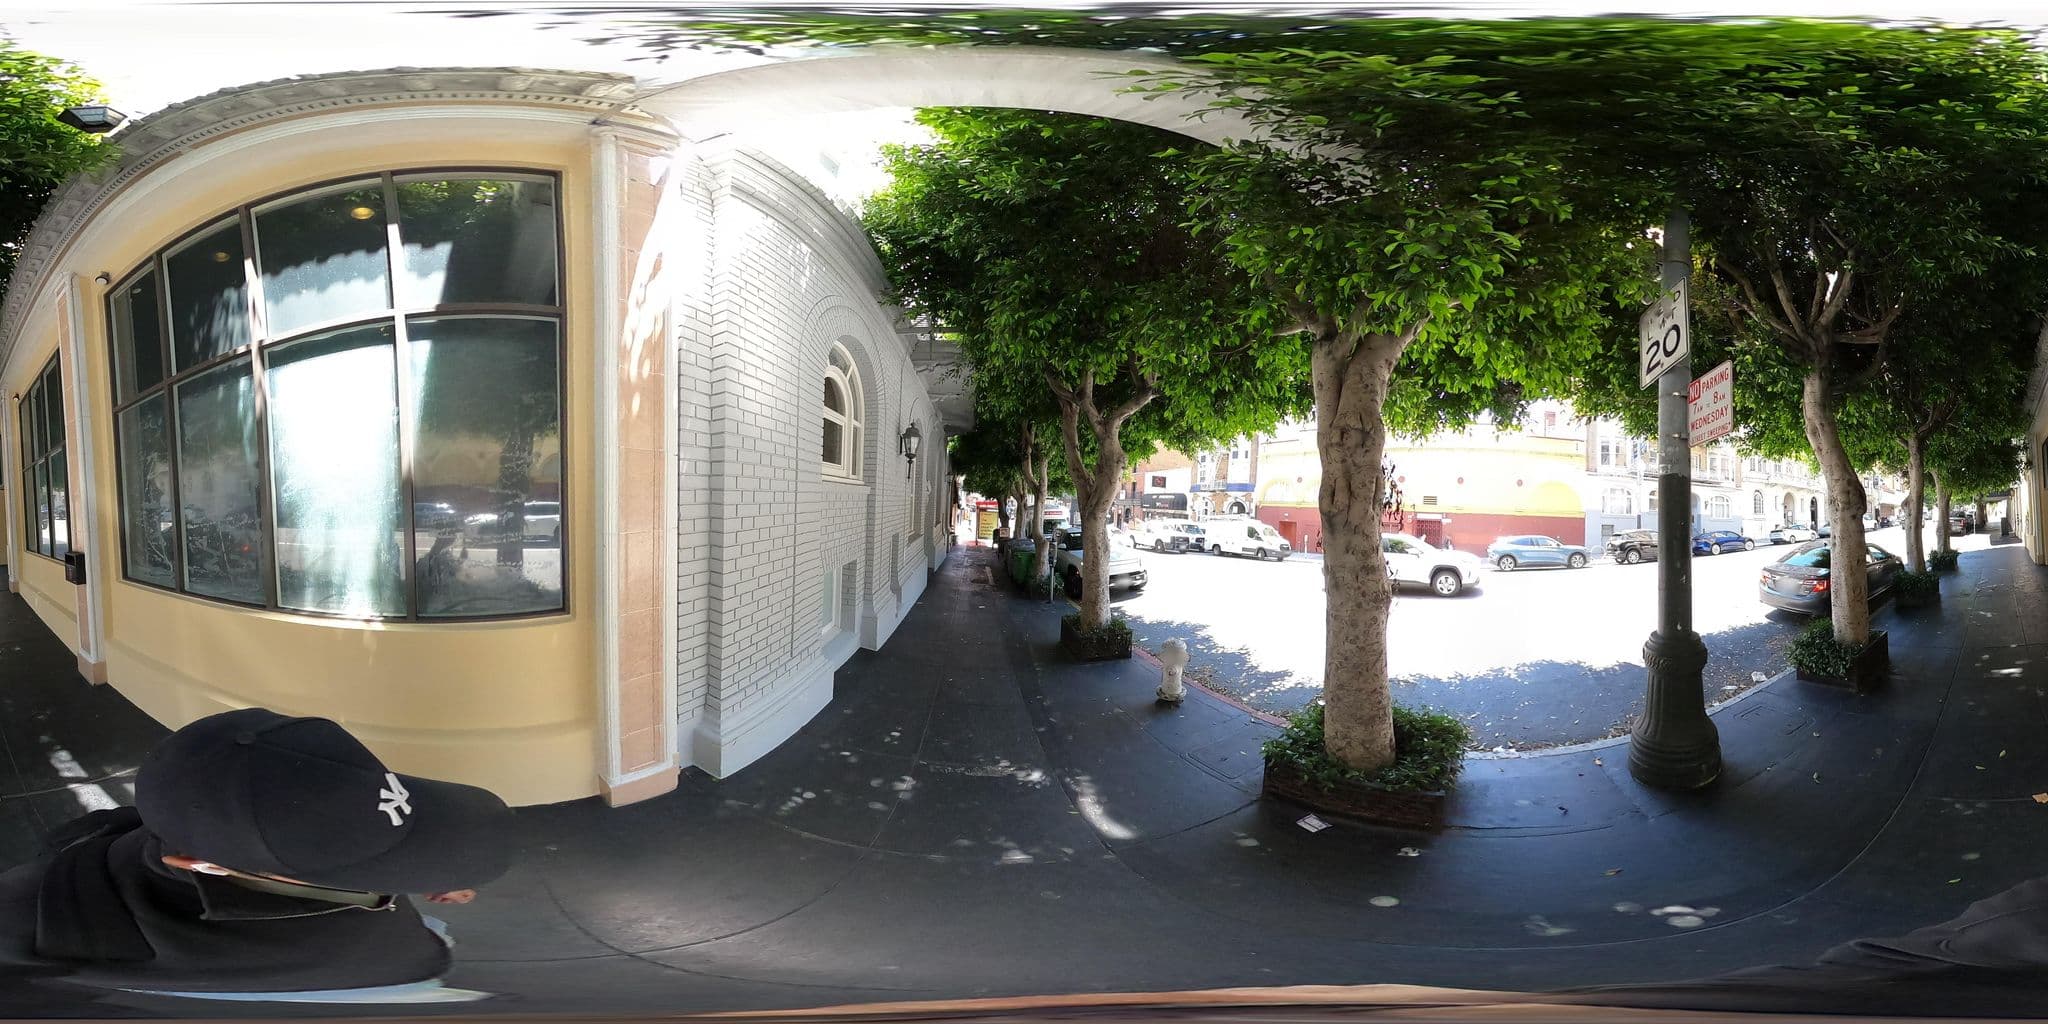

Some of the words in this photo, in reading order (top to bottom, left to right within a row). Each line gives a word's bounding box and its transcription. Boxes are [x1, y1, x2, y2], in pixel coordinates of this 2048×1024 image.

[1645, 323, 1681, 376] 20
[1689, 381, 1699, 402] NO
[1701, 368, 1729, 391] PARKING
[1691, 405, 1729, 431] WEDNESDAY
[1691, 432, 1706, 444] STREET
[377, 772, 412, 826] NY
